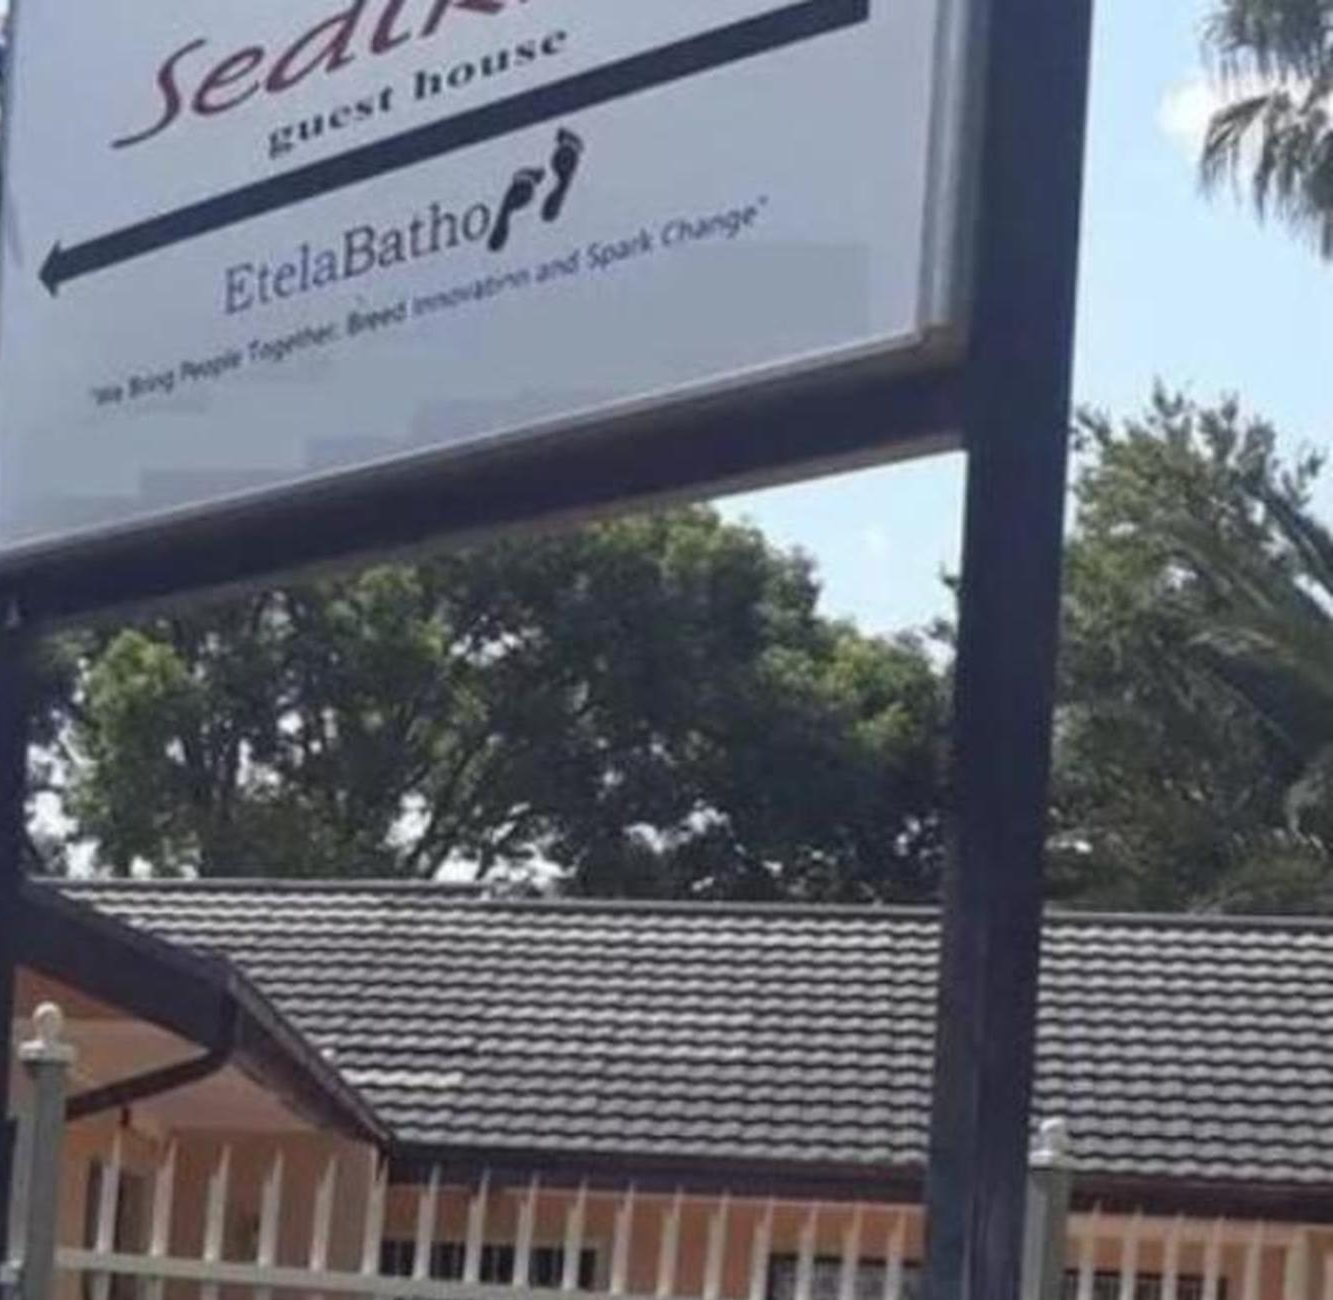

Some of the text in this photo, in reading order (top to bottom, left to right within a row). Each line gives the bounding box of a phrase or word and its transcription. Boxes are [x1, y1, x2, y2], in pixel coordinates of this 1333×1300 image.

[266, 30, 568, 160] guest house
[224, 202, 491, 315] EtelaBatho
[346, 301, 407, 336] Breed
[535, 250, 580, 284] and
[587, 228, 652, 270] Spark
